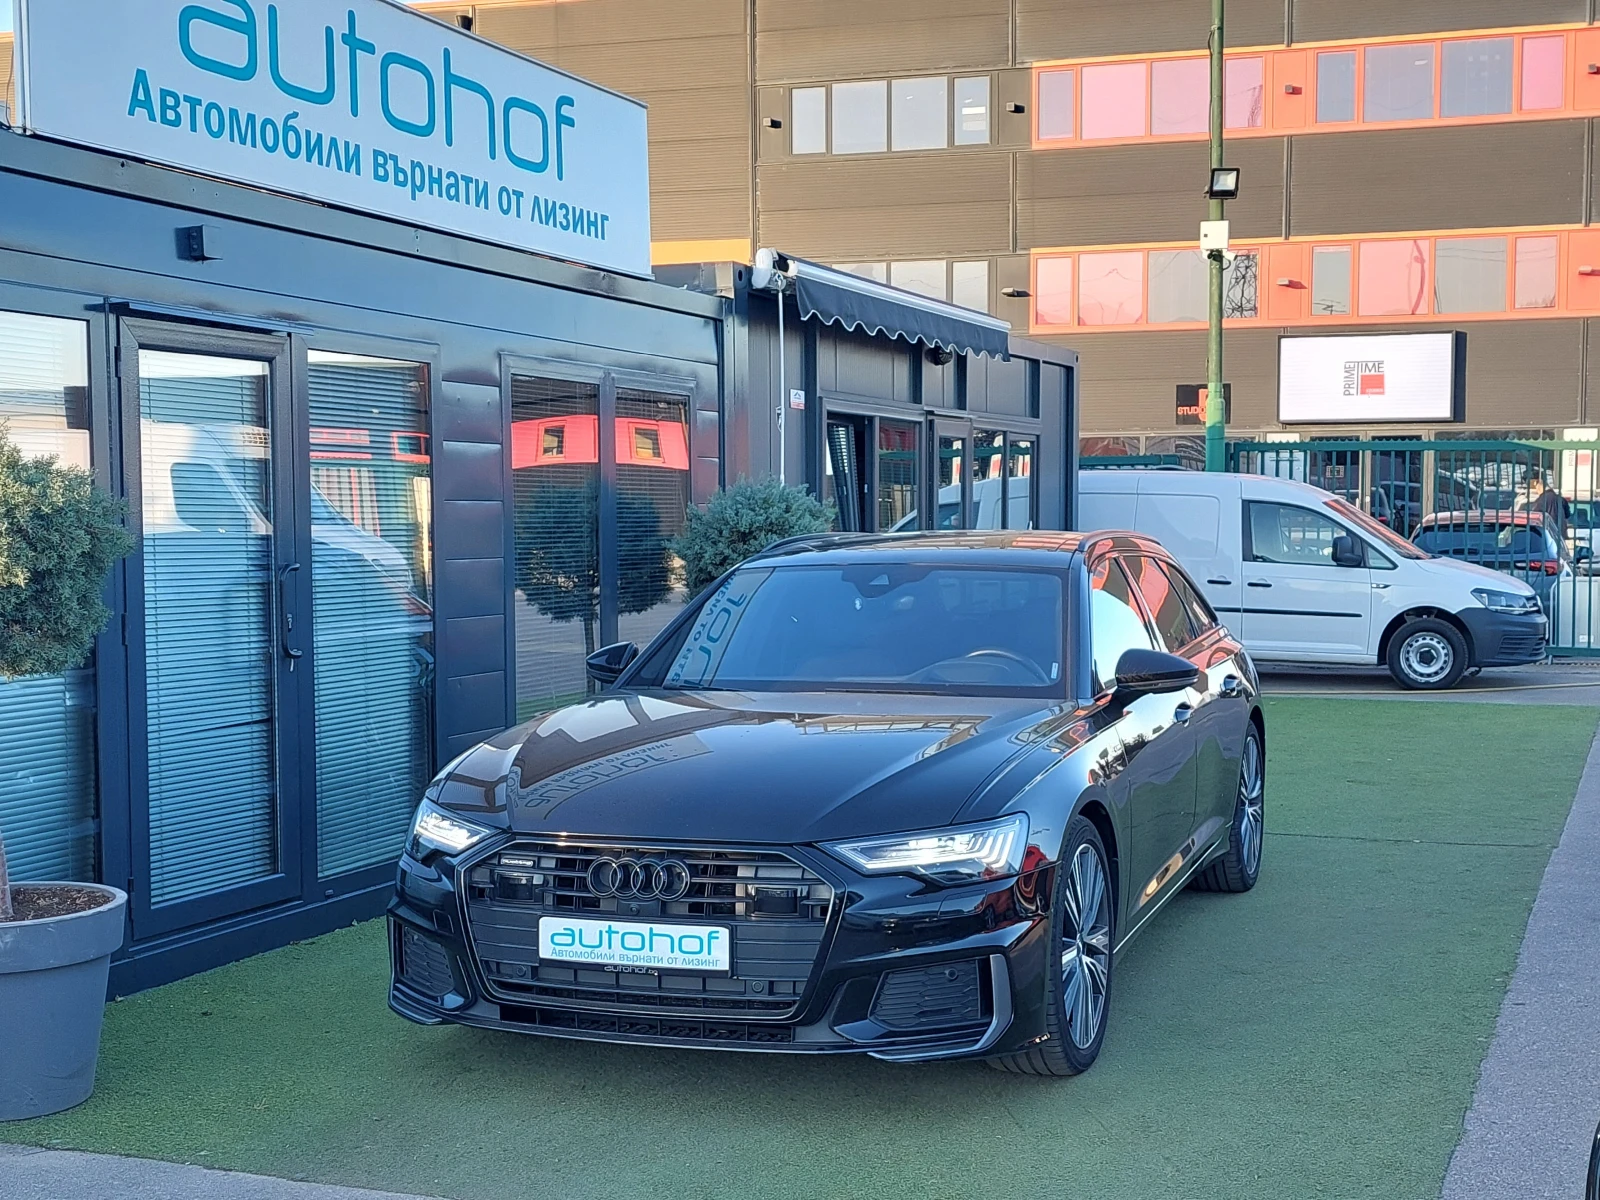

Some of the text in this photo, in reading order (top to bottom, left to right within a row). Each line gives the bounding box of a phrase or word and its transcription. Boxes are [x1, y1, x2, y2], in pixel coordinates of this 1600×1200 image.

[179, 0, 576, 182] autohof
[127, 68, 610, 241] Автомобили върнати от лизинг
[1343, 362, 1356, 396] PRIME
[550, 924, 720, 956] autohof
[550, 946, 721, 968] Автомобили върнати от лизинг
